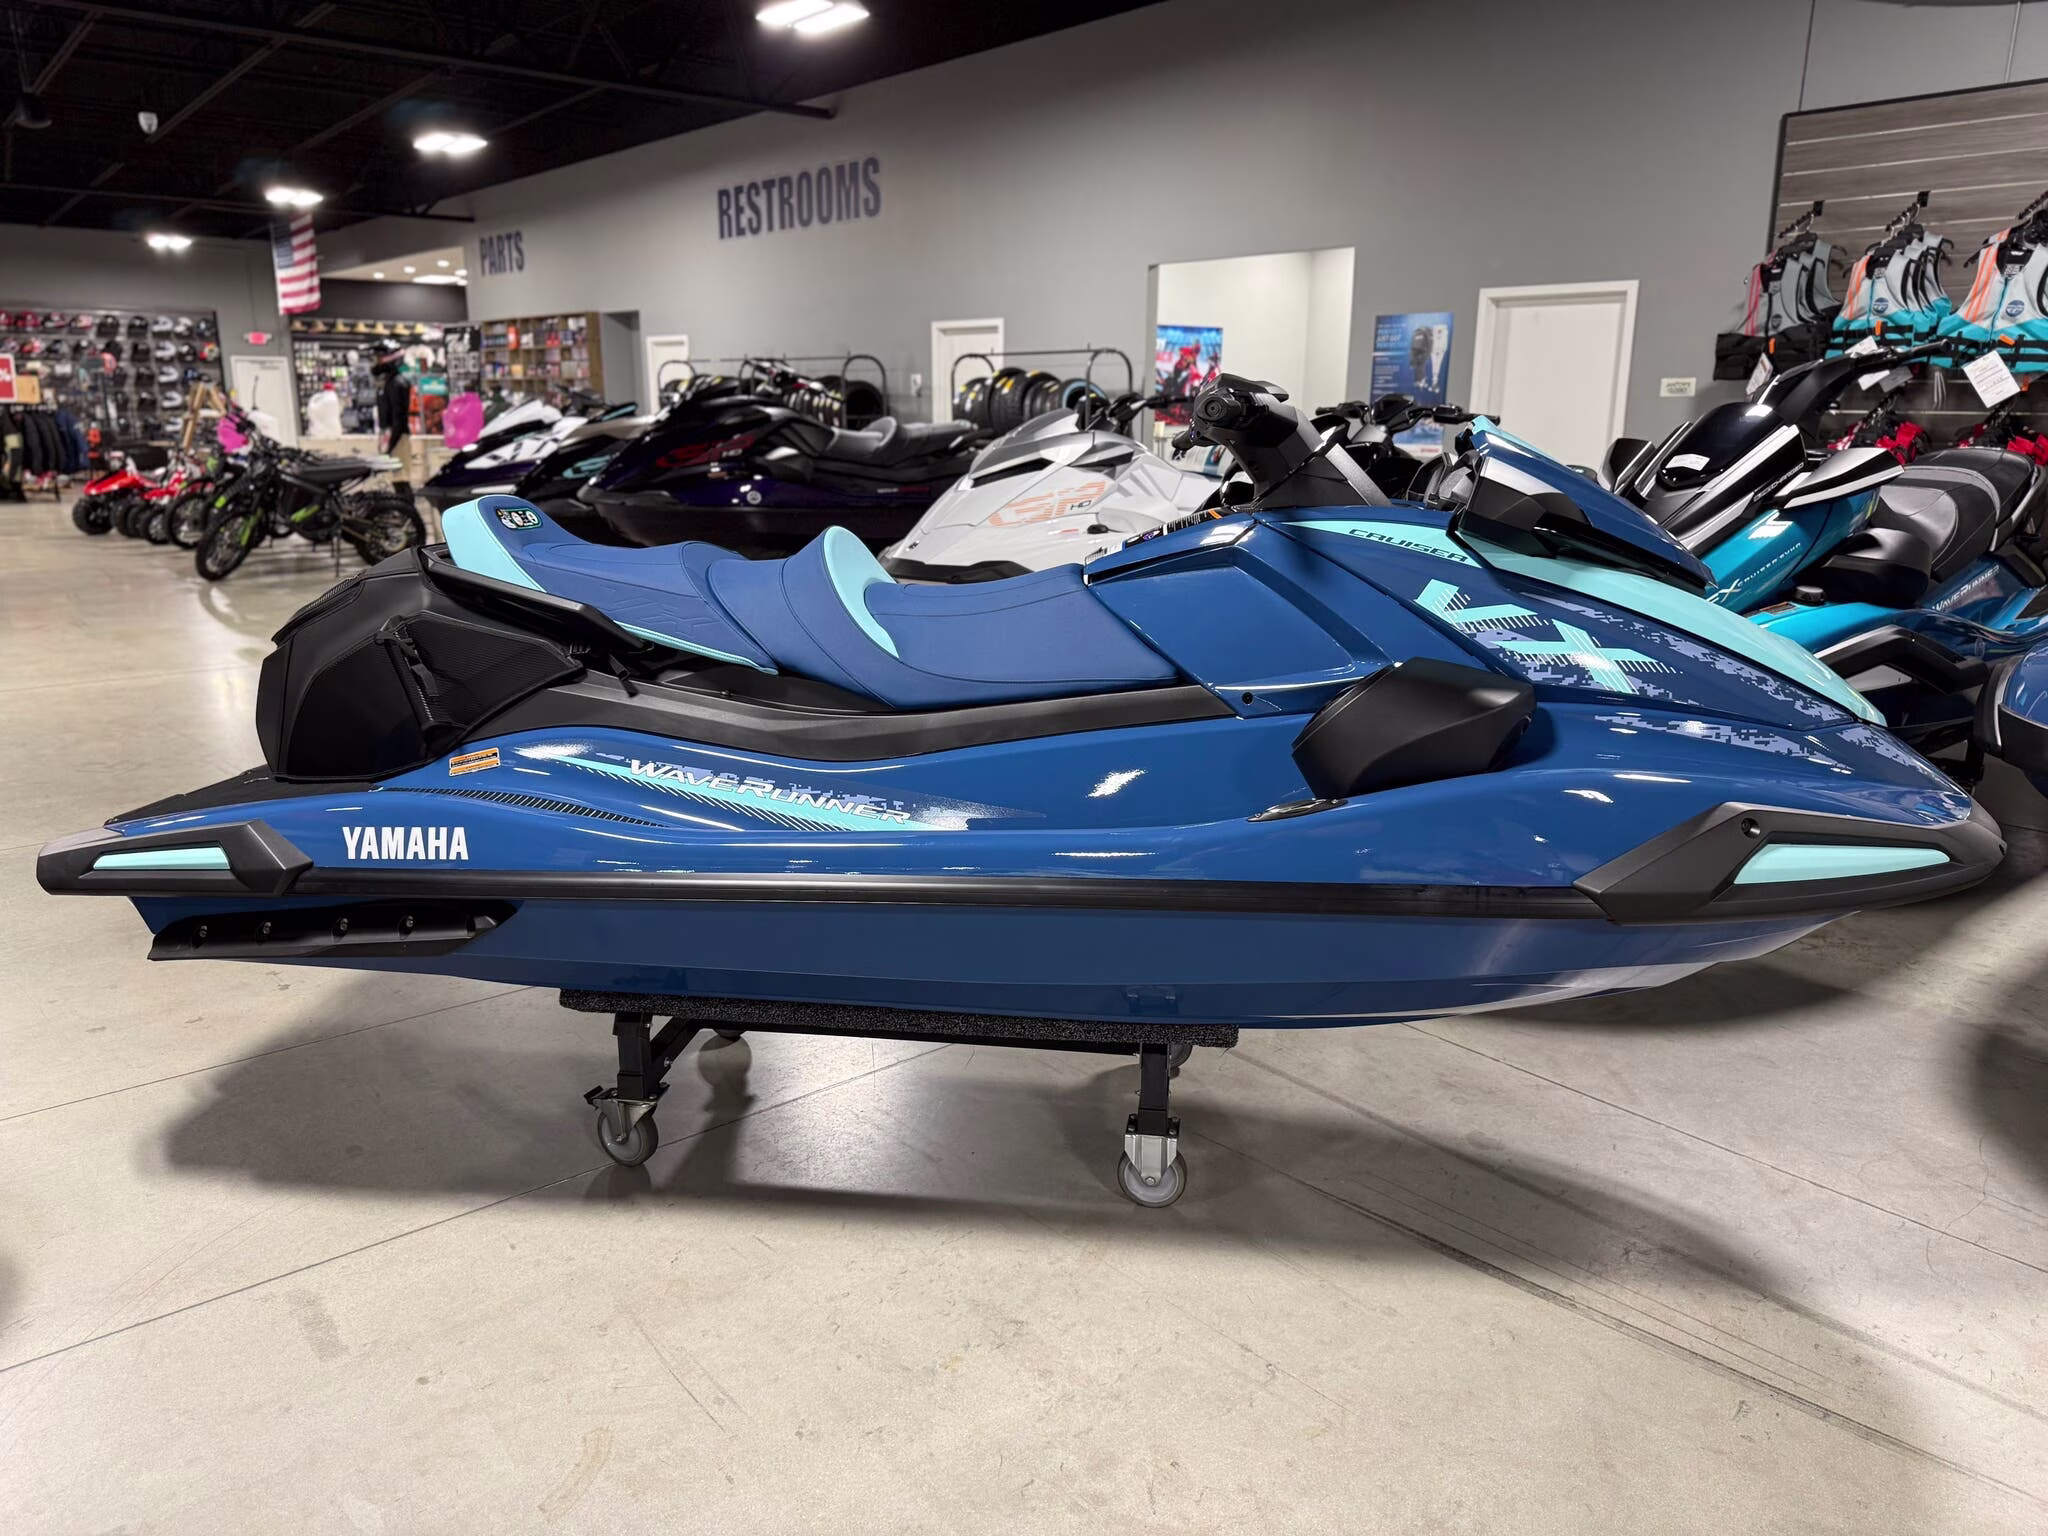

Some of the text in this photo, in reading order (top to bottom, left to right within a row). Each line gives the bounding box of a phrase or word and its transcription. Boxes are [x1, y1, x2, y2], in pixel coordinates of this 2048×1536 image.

[717, 156, 881, 239] RESTROOMS
[480, 231, 525, 276] PARTS
[1348, 529, 1469, 562] CRUISER
[341, 826, 470, 861] YAMAHA
